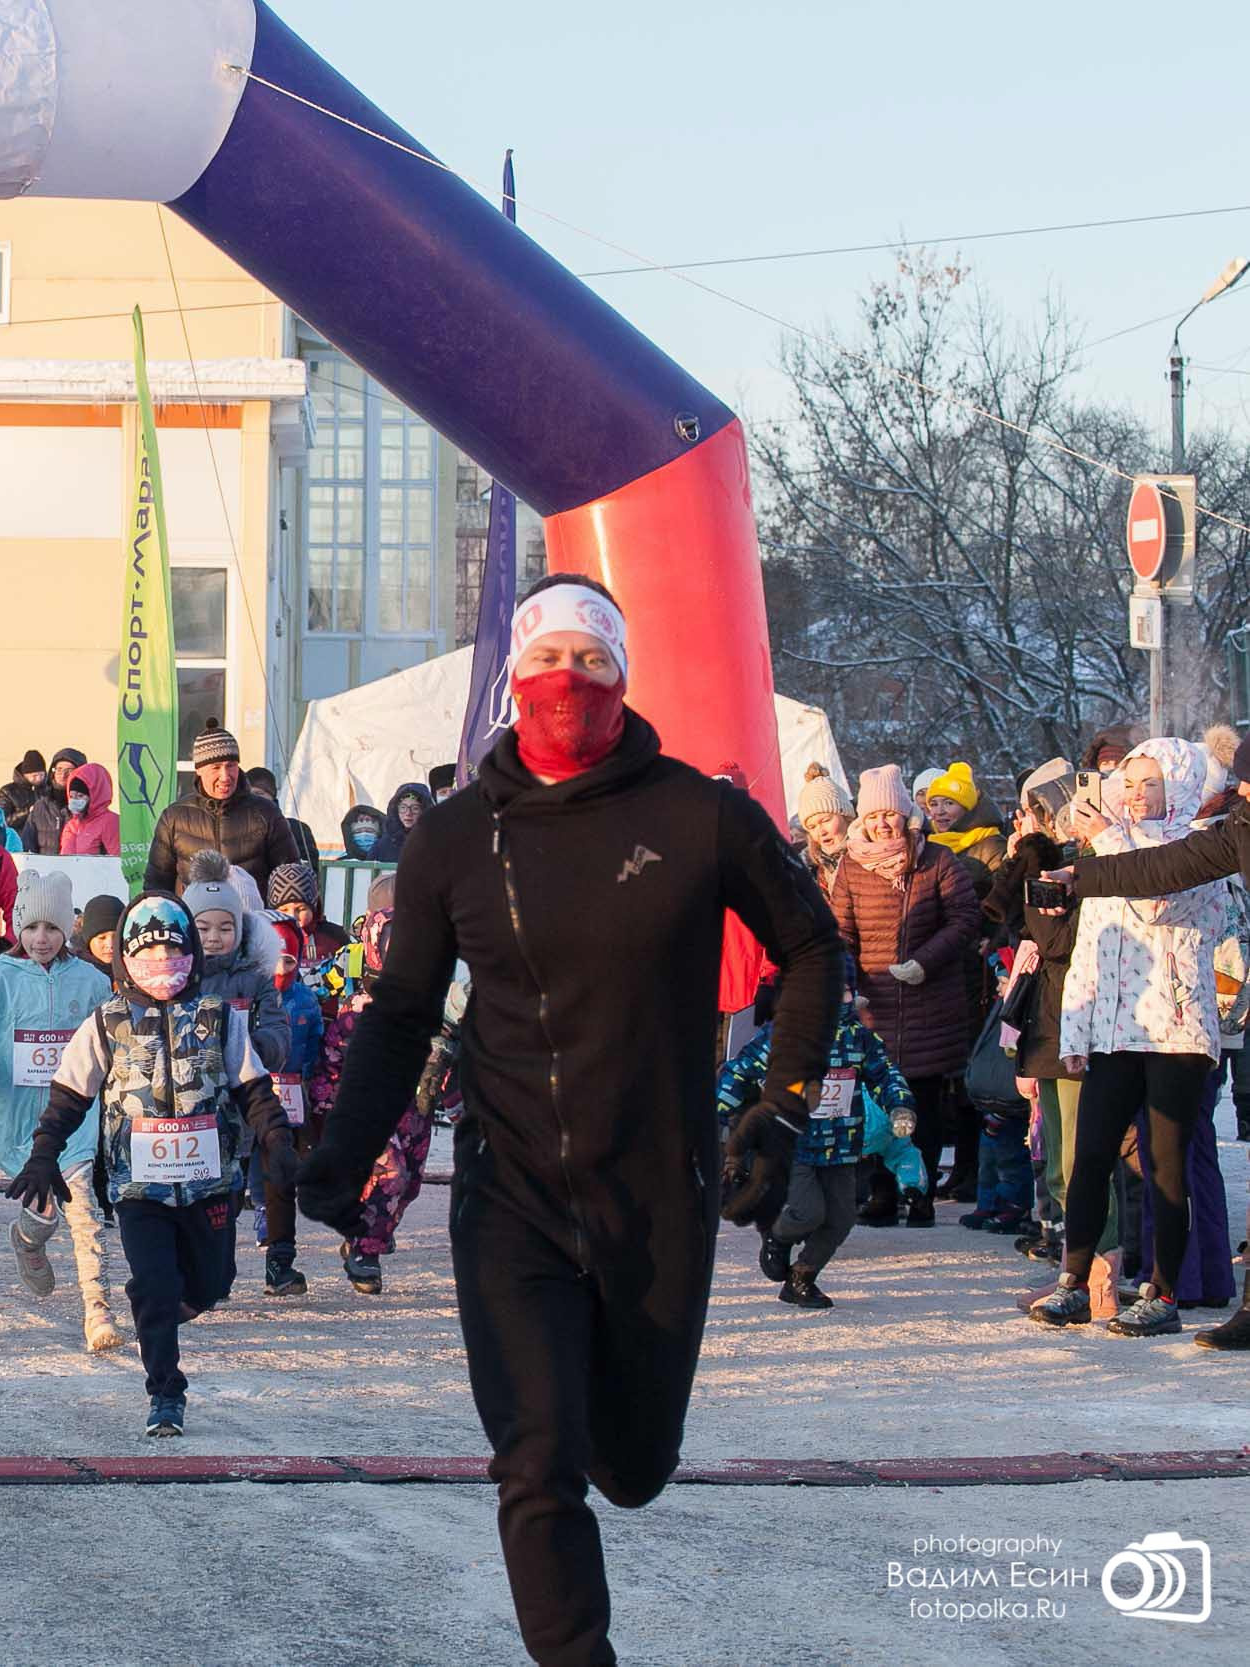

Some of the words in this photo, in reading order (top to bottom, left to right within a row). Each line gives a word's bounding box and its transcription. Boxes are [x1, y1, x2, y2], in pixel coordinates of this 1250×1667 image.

[38, 1034, 56, 1042] 600
[31, 1046, 63, 1067] 63
[820, 1083, 842, 1101] 22
[157, 1123, 179, 1132] 600
[151, 1136, 201, 1160] 612
